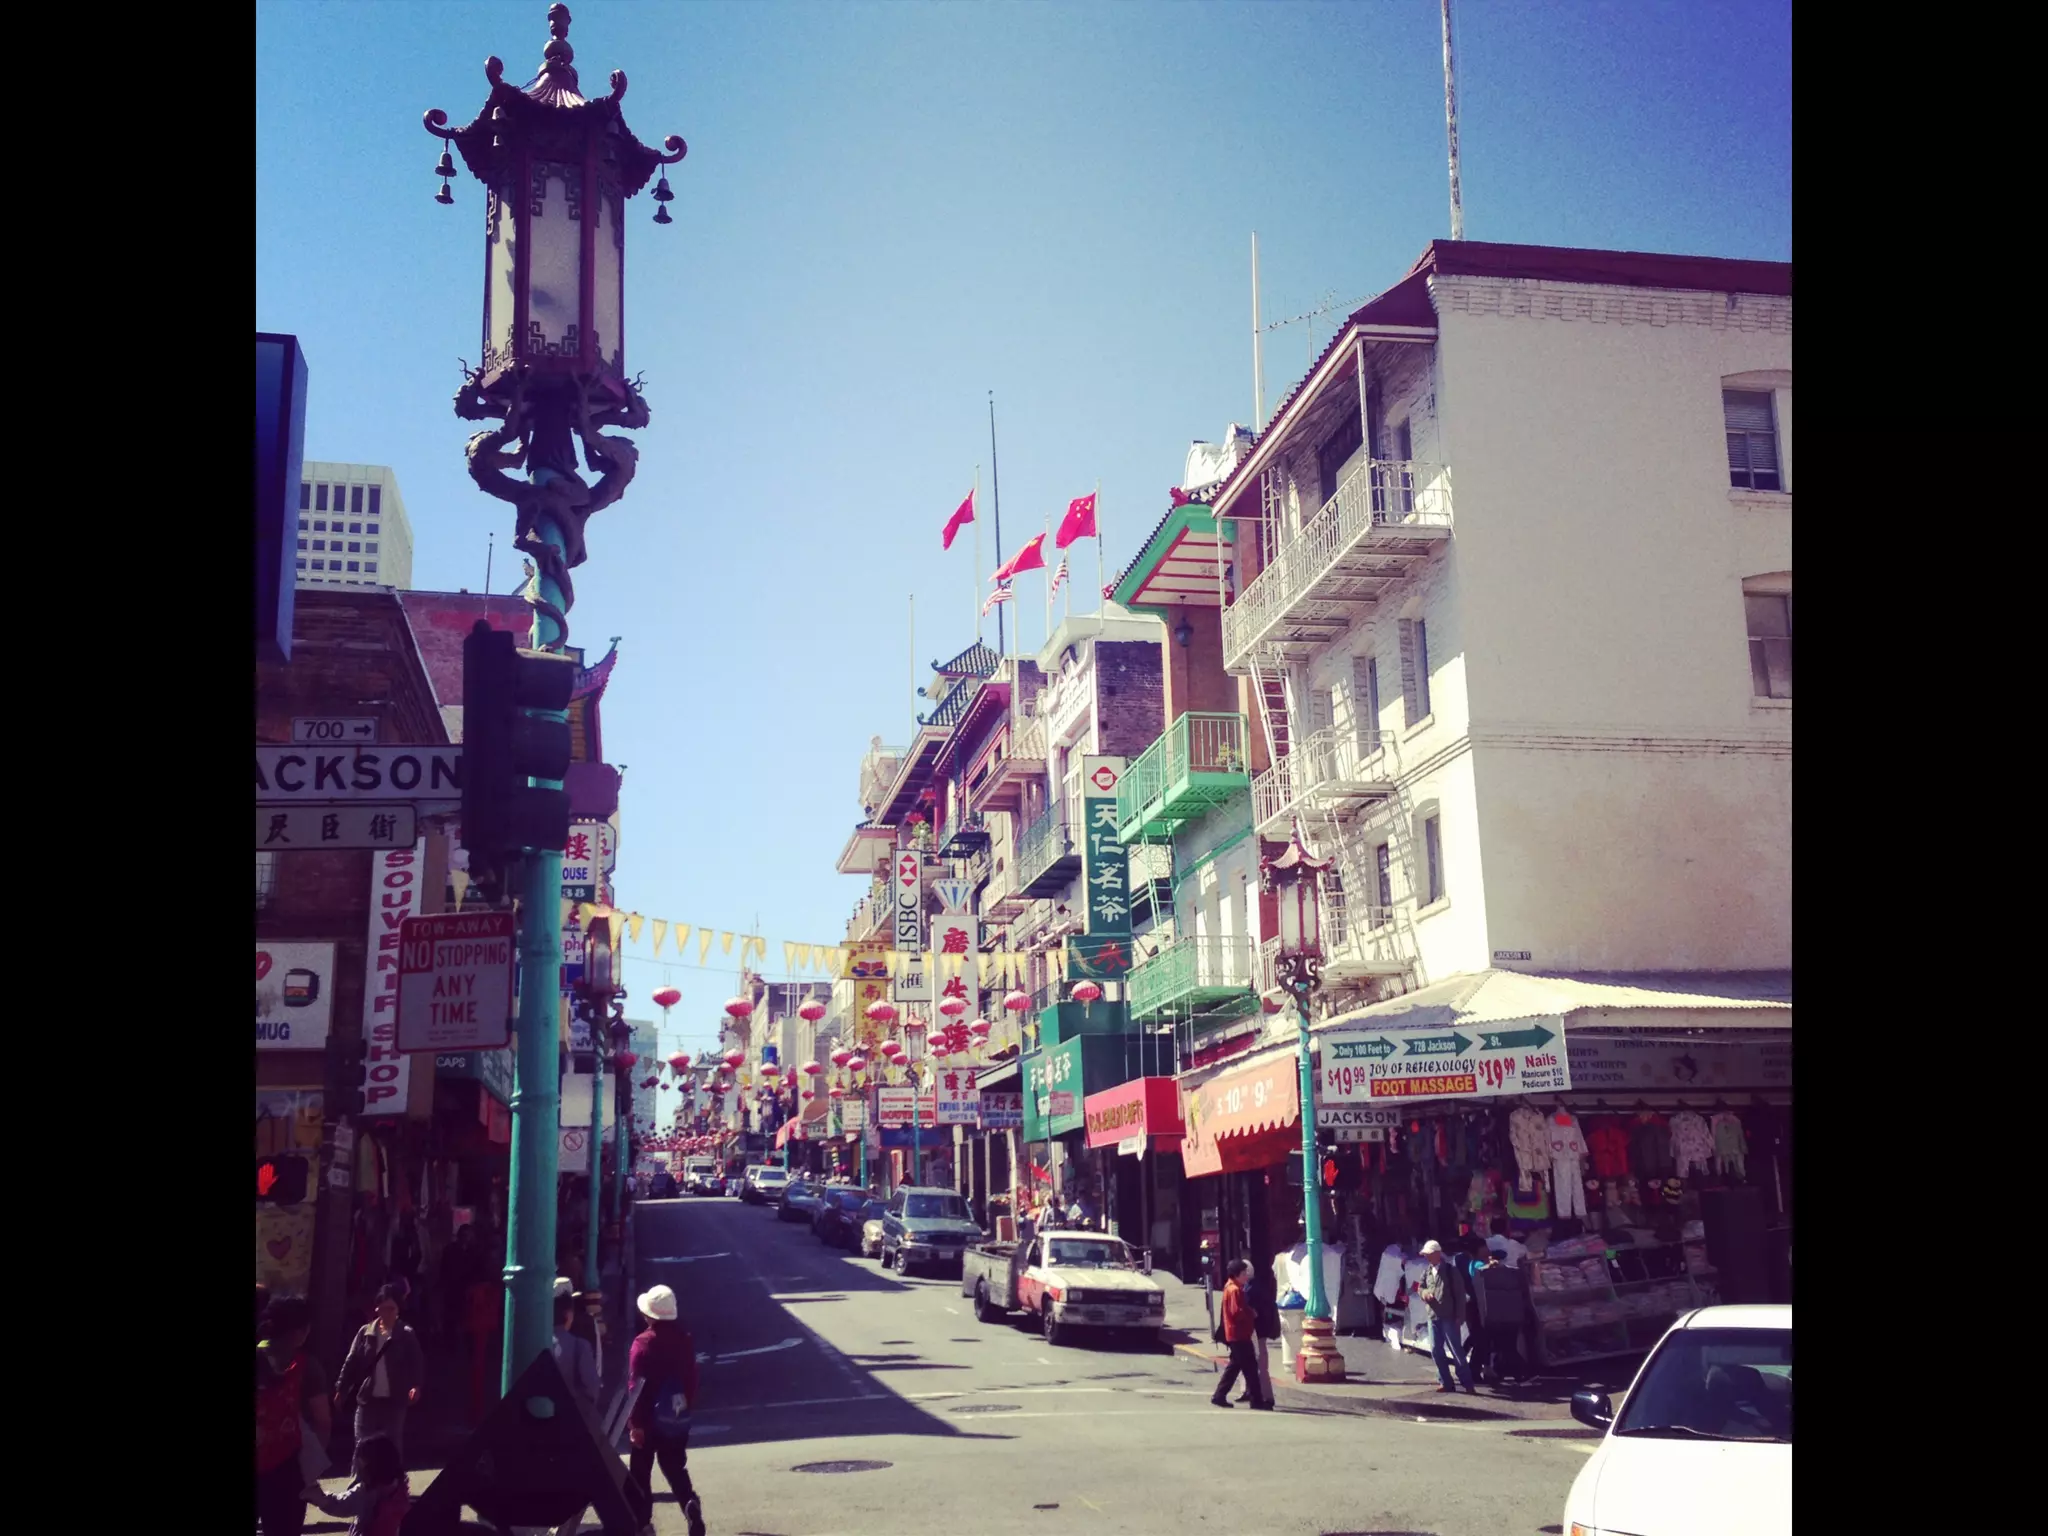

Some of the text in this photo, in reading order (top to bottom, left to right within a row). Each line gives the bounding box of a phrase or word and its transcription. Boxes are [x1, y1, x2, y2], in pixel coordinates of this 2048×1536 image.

[303, 721, 344, 739] 700
[411, 917, 504, 937] TOW-AWAY
[899, 893, 921, 962] HSBC
[401, 940, 508, 970] NO STOPPING
[433, 974, 476, 998] ANY
[430, 1002, 478, 1026] TIME
[256, 1022, 290, 1040] MUG
[1338, 1047, 1353, 1058] Only
[1354, 1046, 1367, 1055] 100
[1367, 1045, 1383, 1055] Feet
[1383, 1046, 1391, 1054] to
[1427, 1039, 1456, 1051] Jackson
[1490, 1035, 1502, 1047] St.
[436, 1057, 466, 1068] CAPS
[1369, 1058, 1476, 1078] JOY OF REFLEXOLOGY
[1525, 1053, 1557, 1068] Nails
[1521, 1069, 1551, 1079] Manicure
[1522, 1078, 1565, 1089] Pedicure $22
[1374, 1076, 1474, 1095] FOOT MASSAGE
[1320, 1110, 1397, 1125] JACKSON
